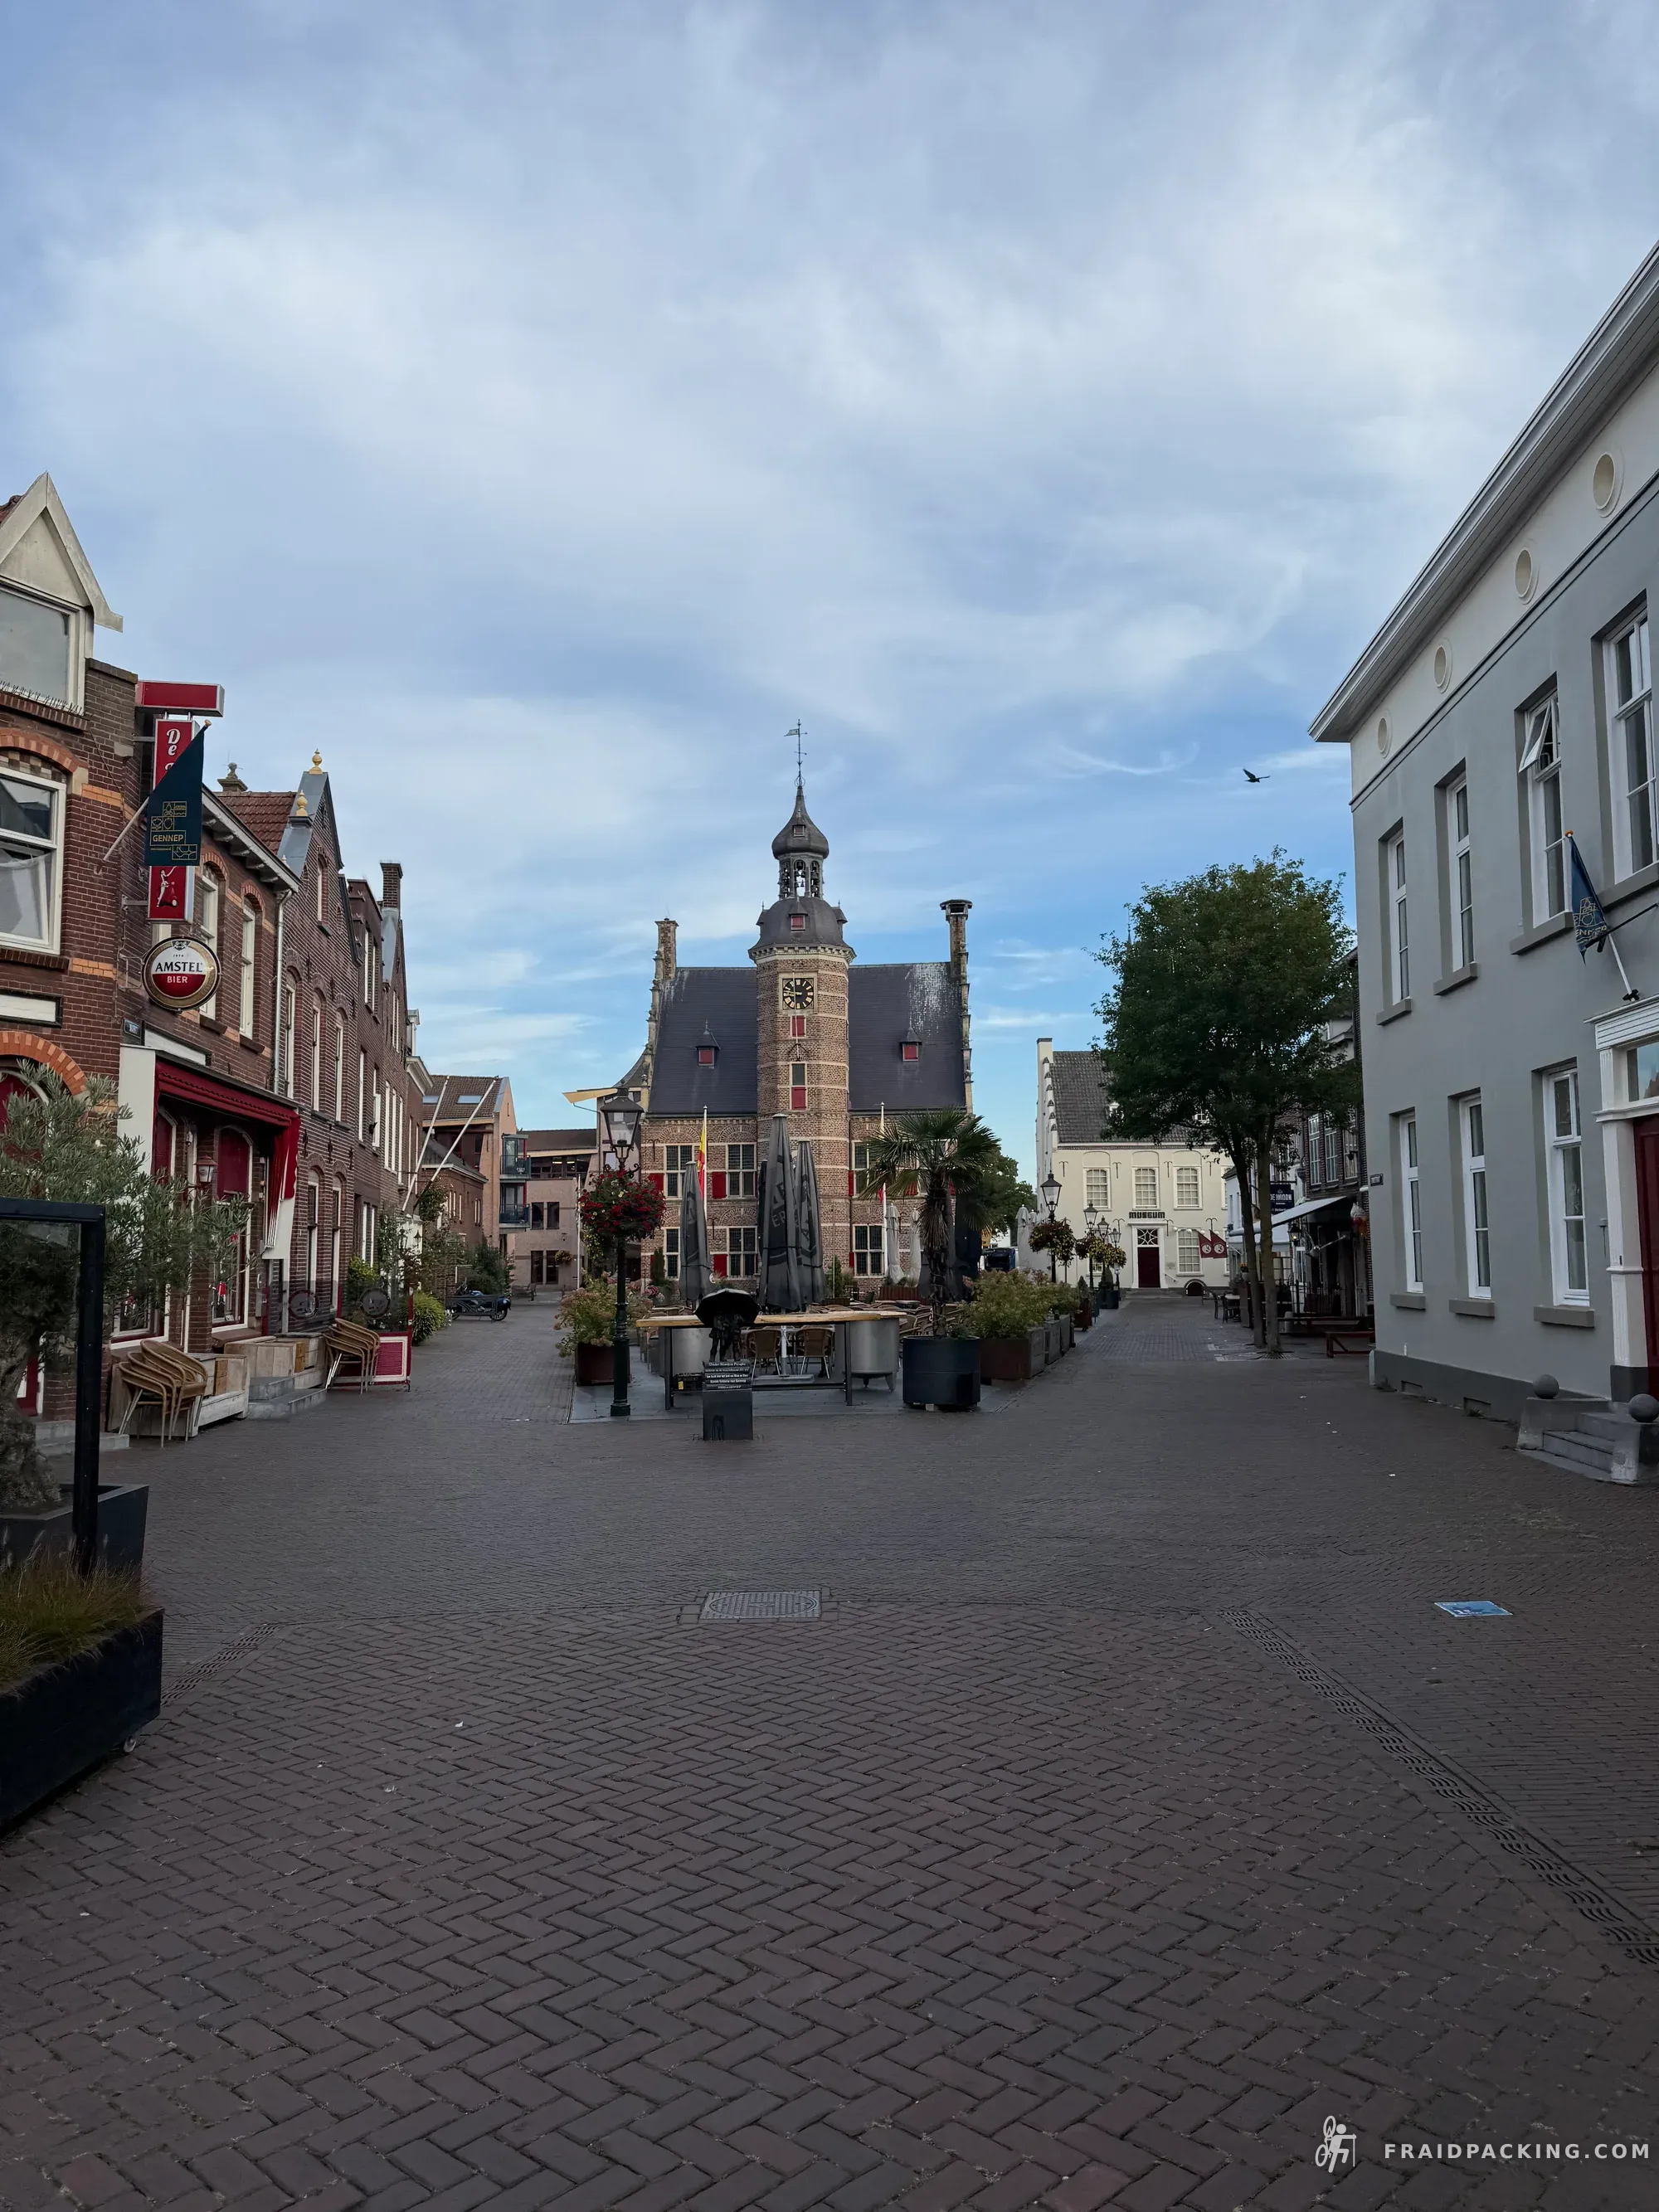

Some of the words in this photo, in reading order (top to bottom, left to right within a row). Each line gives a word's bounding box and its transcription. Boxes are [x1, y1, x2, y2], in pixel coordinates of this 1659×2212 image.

[166, 728, 181, 756] De
[155, 961, 203, 973] AMSTEL
[167, 975, 188, 984] BIER
